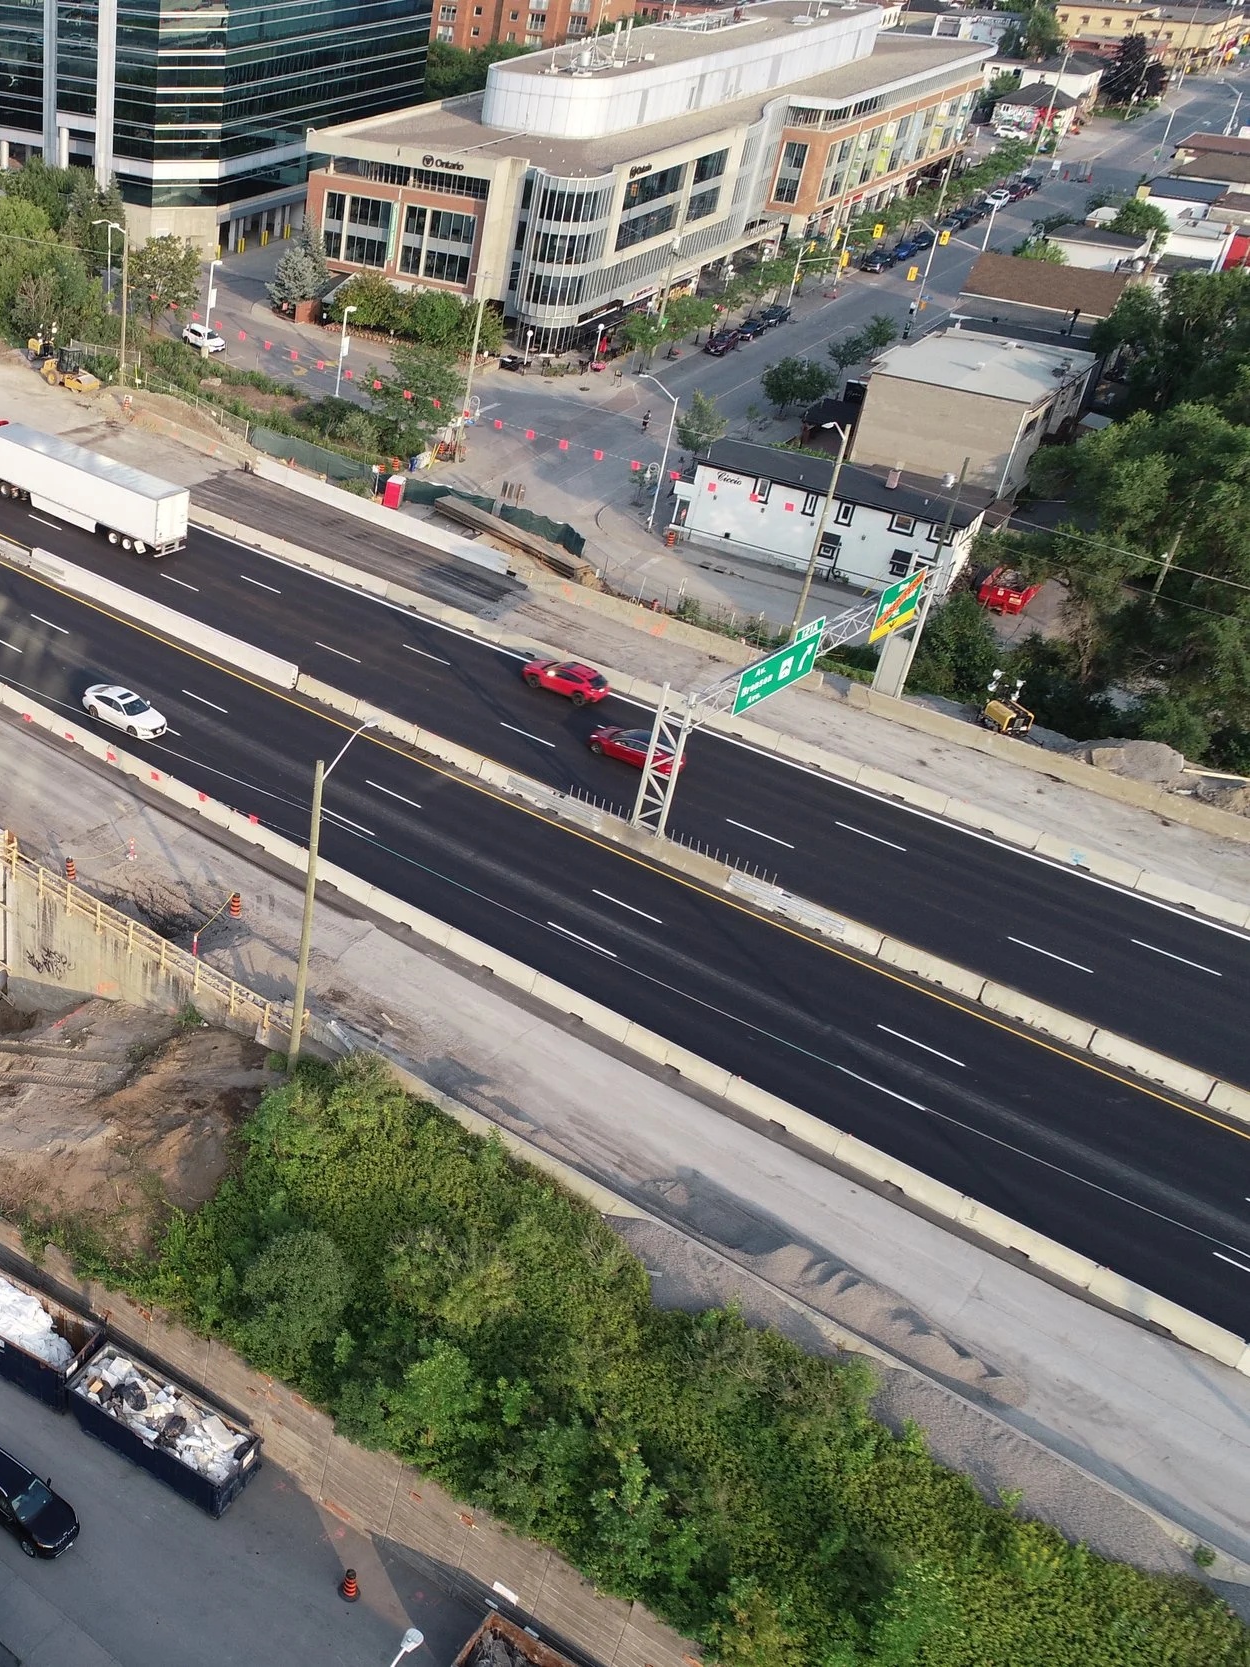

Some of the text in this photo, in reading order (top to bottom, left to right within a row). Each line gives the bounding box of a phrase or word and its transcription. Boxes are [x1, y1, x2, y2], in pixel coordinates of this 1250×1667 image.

[435, 158, 464, 171] Ontario
[717, 471, 742, 485] Ciccio
[801, 623, 818, 639] 121A
